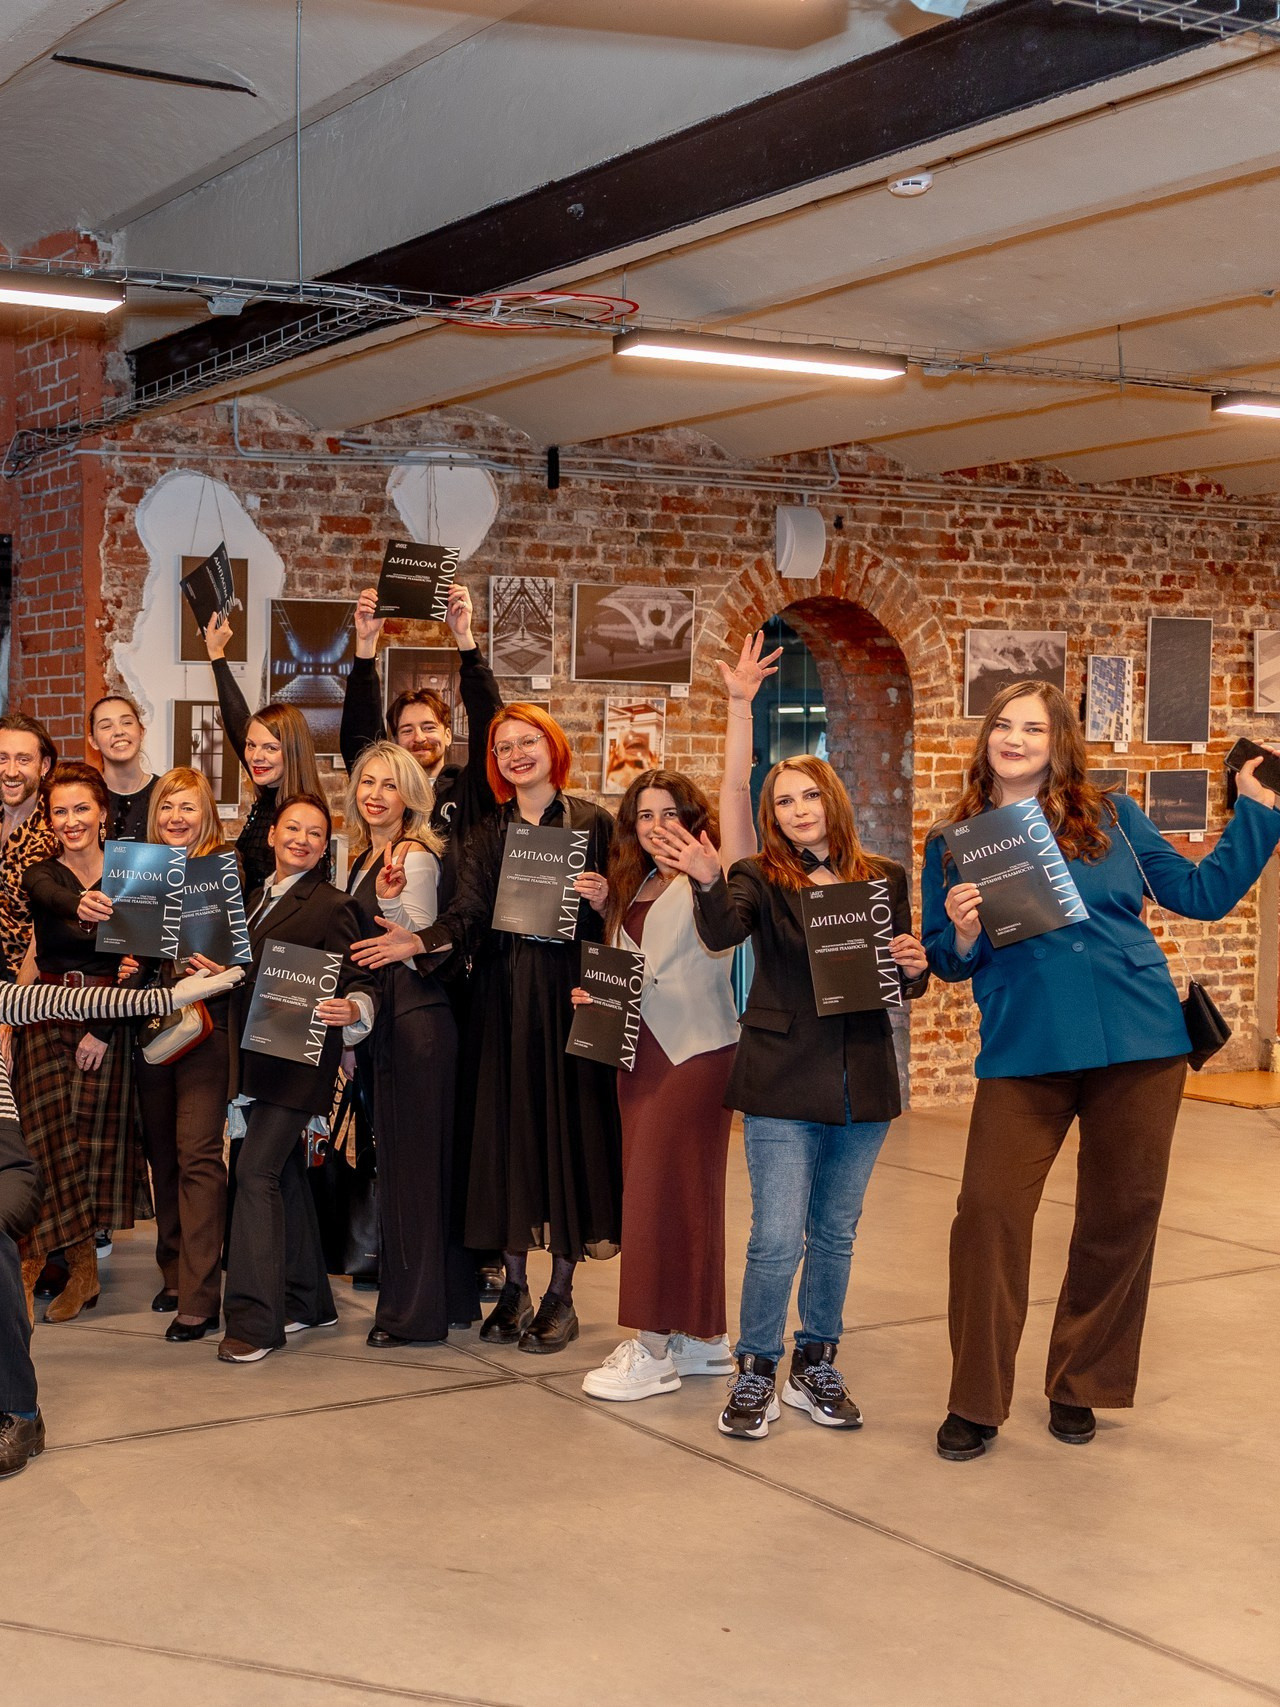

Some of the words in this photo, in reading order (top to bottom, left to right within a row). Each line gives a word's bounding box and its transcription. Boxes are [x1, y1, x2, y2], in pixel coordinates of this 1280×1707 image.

[388, 556, 437, 569] ДИПЛОМ
[430, 547, 461, 622] ДИПЛОМ
[509, 849, 564, 864] ДИПЛОМ
[962, 834, 1026, 865] ДИПЛОМ
[1015, 796, 1090, 919] ДИПЛОМ
[108, 868, 162, 882] ДИПЛОМ
[184, 881, 220, 895] ПЛОМ
[557, 830, 590, 940] ДИПЛОМ
[160, 846, 187, 960] ДИПЛОМ
[218, 851, 253, 962] ДИПЛОМ
[810, 911, 868, 928] ДИПЛОМ
[867, 878, 903, 1007] ДИПЛОМ
[263, 966, 316, 986] ДИПЛОМ
[584, 969, 627, 988] ДИПЛОМ
[620, 953, 645, 1072] ДИПЛОМ
